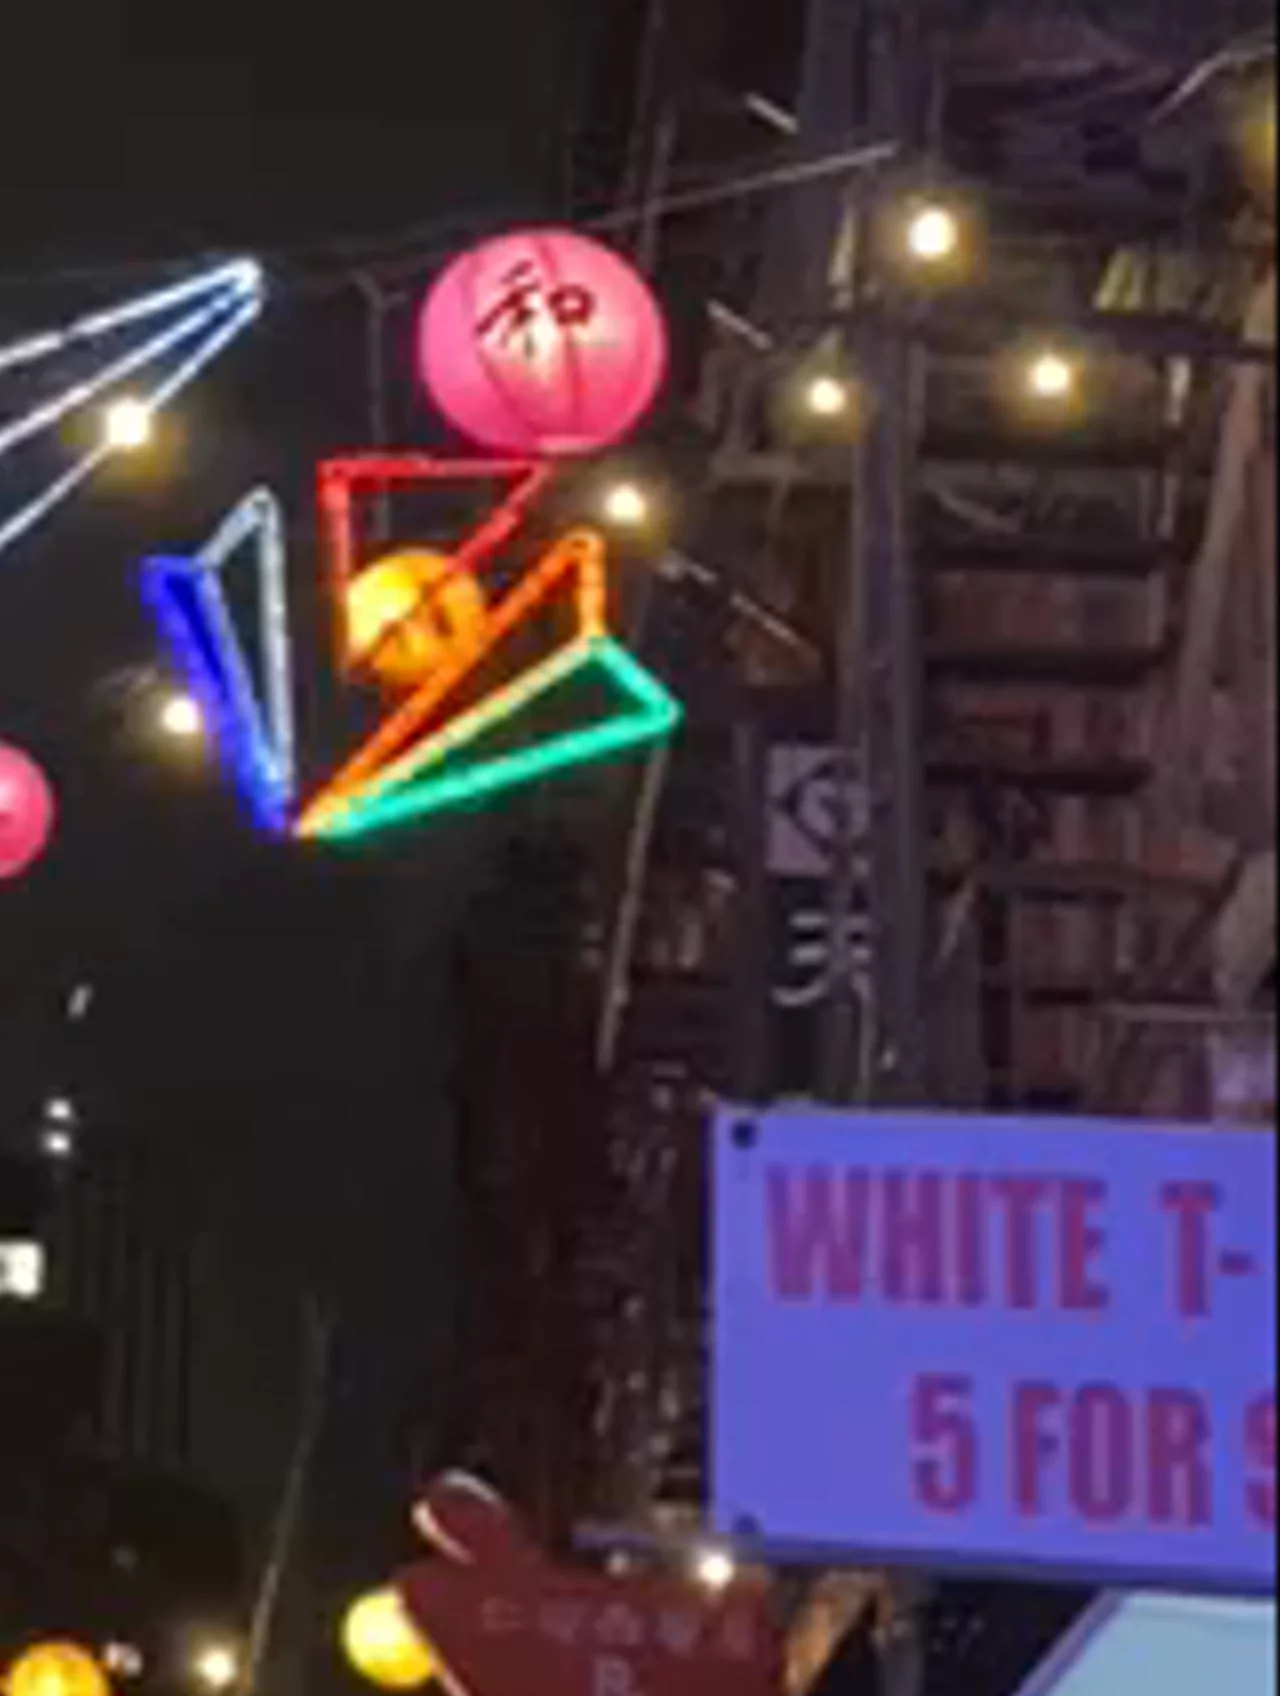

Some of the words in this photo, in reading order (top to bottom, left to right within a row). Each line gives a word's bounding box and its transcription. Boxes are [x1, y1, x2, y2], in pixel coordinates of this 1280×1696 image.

[765, 1165, 1109, 1311] WHITE
[1158, 1179, 1256, 1319] T-
[912, 1371, 975, 1515] 5
[1007, 1380, 1213, 1531] FOR
